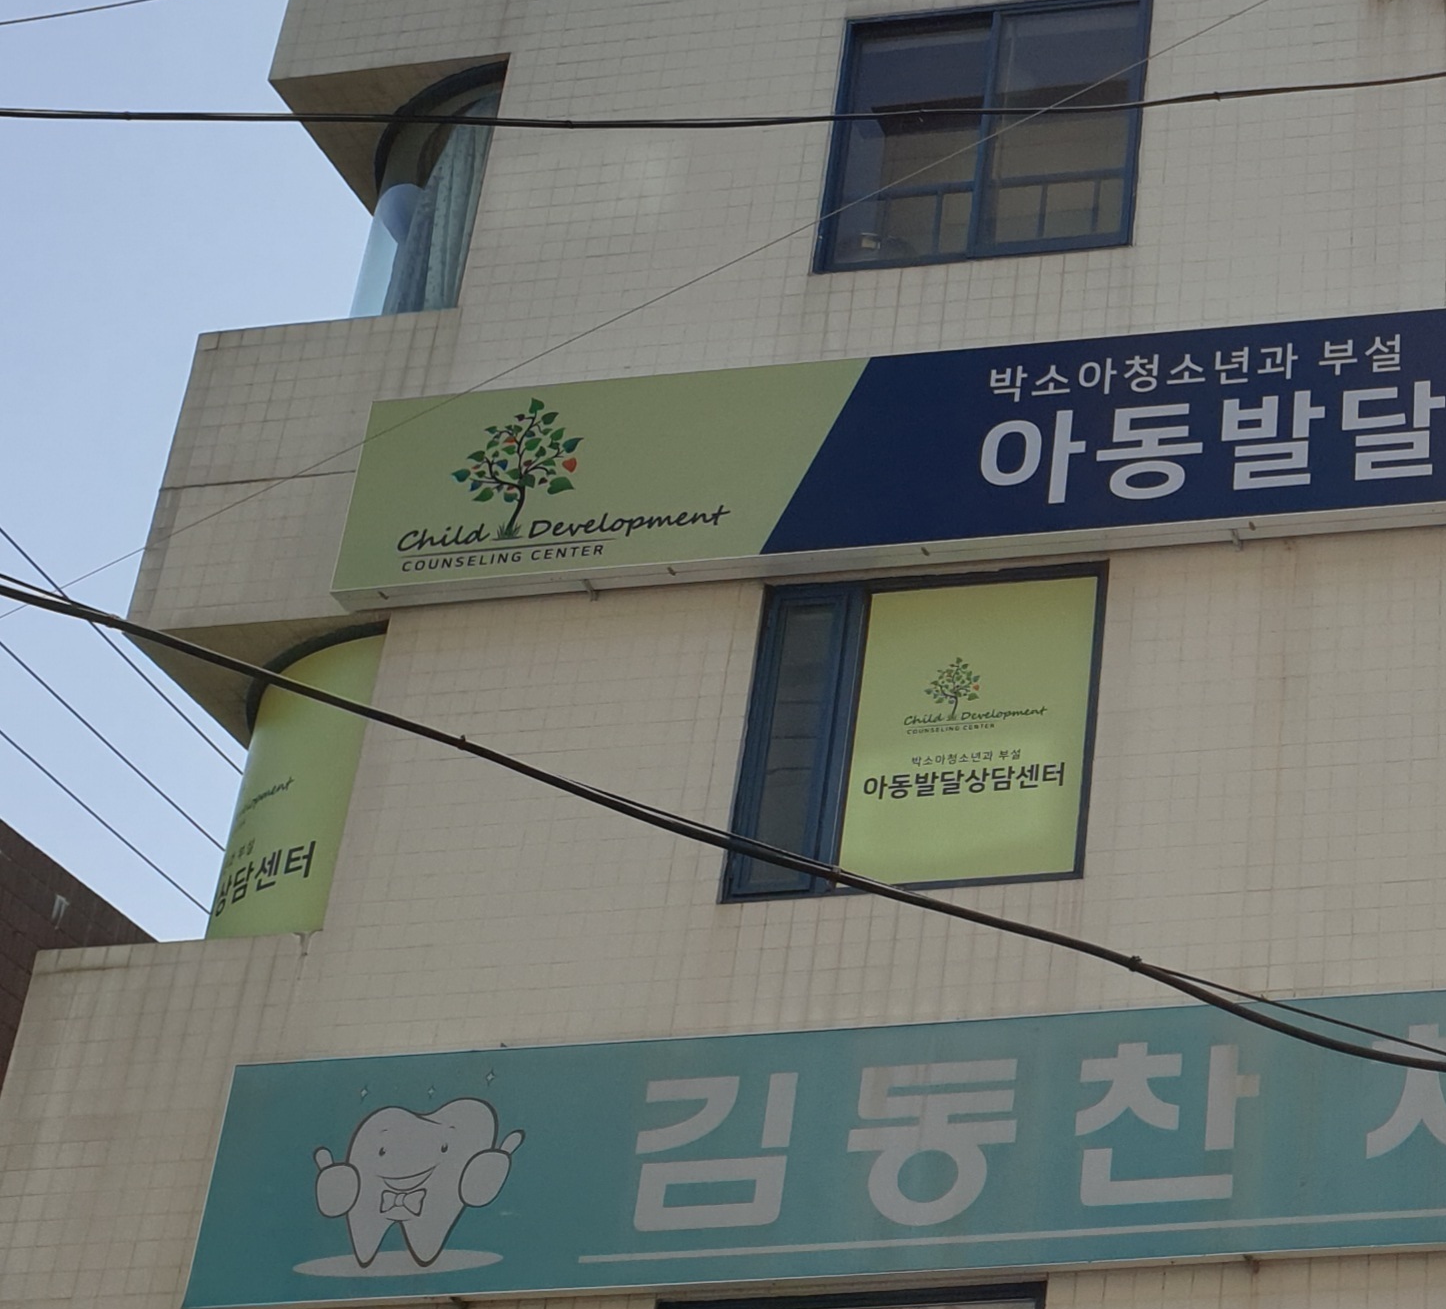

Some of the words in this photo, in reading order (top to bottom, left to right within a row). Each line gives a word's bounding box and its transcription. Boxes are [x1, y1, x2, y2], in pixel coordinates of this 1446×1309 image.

[989, 342, 1299, 402] 박소아청소년과
[1318, 334, 1402, 376] 부설
[397, 523, 491, 552] Child
[528, 504, 731, 538] Development
[401, 550, 522, 573] COUNSELING
[531, 544, 604, 562] CENTER
[904, 713, 944, 726] Child
[960, 706, 1048, 721] Development
[906, 726, 960, 735] COUNSELING
[962, 723, 995, 732] CENTER
[911, 751, 993, 767] 박소아청소년과
[998, 748, 1022, 761] 부설
[863, 762, 1066, 800] 아동발달상담센터
[632, 1041, 1260, 1232] 김동찬
